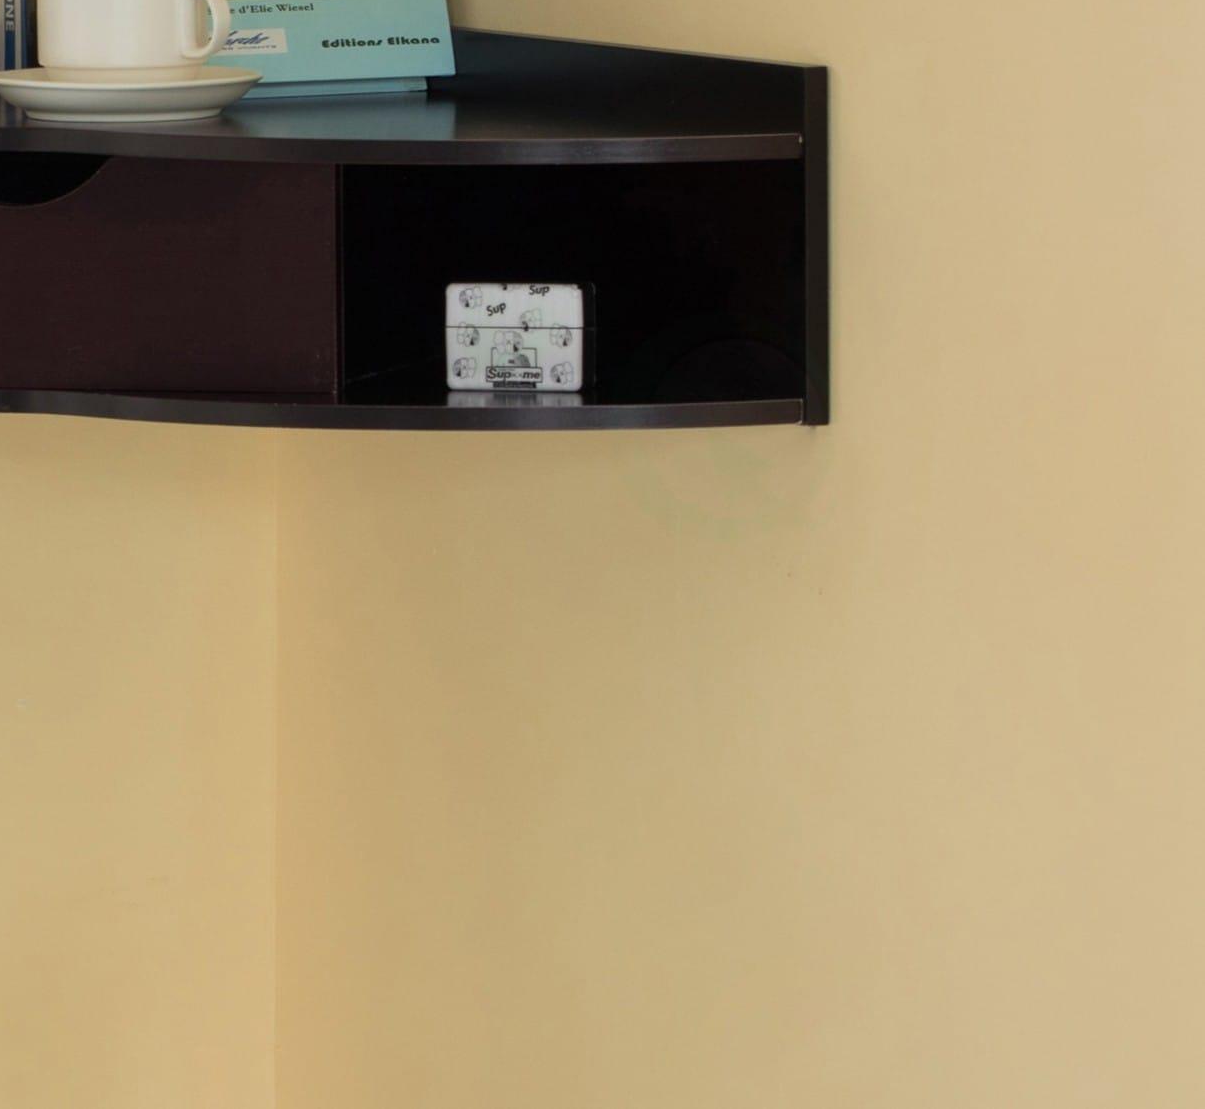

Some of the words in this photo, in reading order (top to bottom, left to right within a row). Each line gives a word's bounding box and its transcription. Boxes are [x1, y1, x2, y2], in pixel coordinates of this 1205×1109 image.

[238, 3, 273, 14] d'Elie
[276, 1, 315, 13] Wiesel
[321, 37, 384, 49] Editions
[387, 35, 441, 47] Elkana
[528, 283, 551, 296] Sup
[485, 302, 507, 317] Sup
